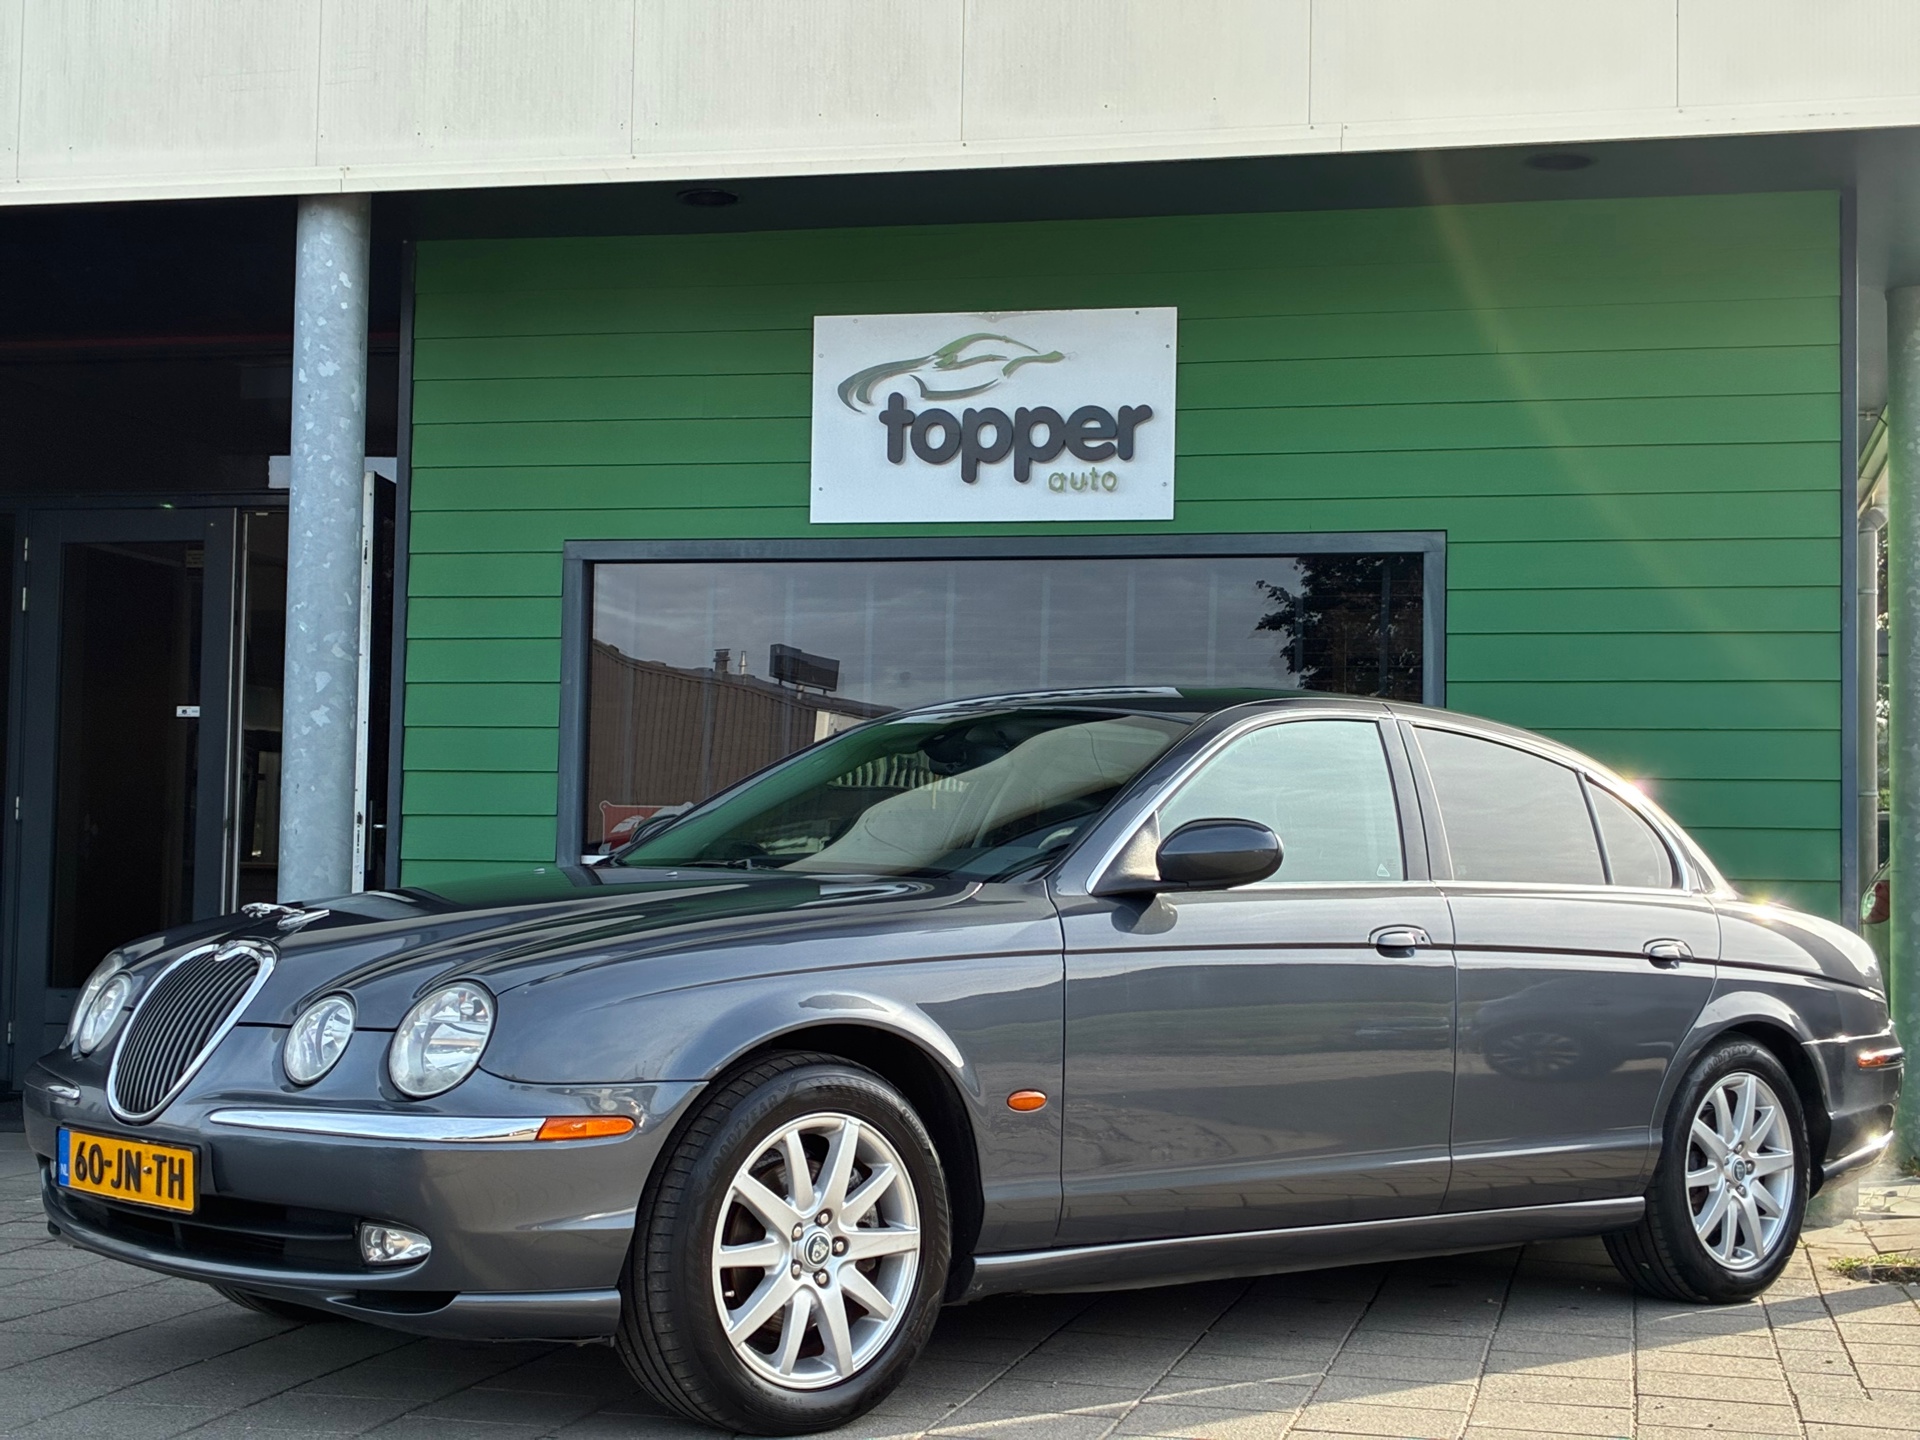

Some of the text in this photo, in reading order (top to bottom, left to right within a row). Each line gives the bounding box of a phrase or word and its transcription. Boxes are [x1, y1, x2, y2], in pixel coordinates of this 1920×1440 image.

[878, 391, 1153, 484] topper
[1048, 467, 1118, 492] auto
[60, 1163, 69, 1177] NL
[75, 1141, 185, 1201] 60-JN-TH
